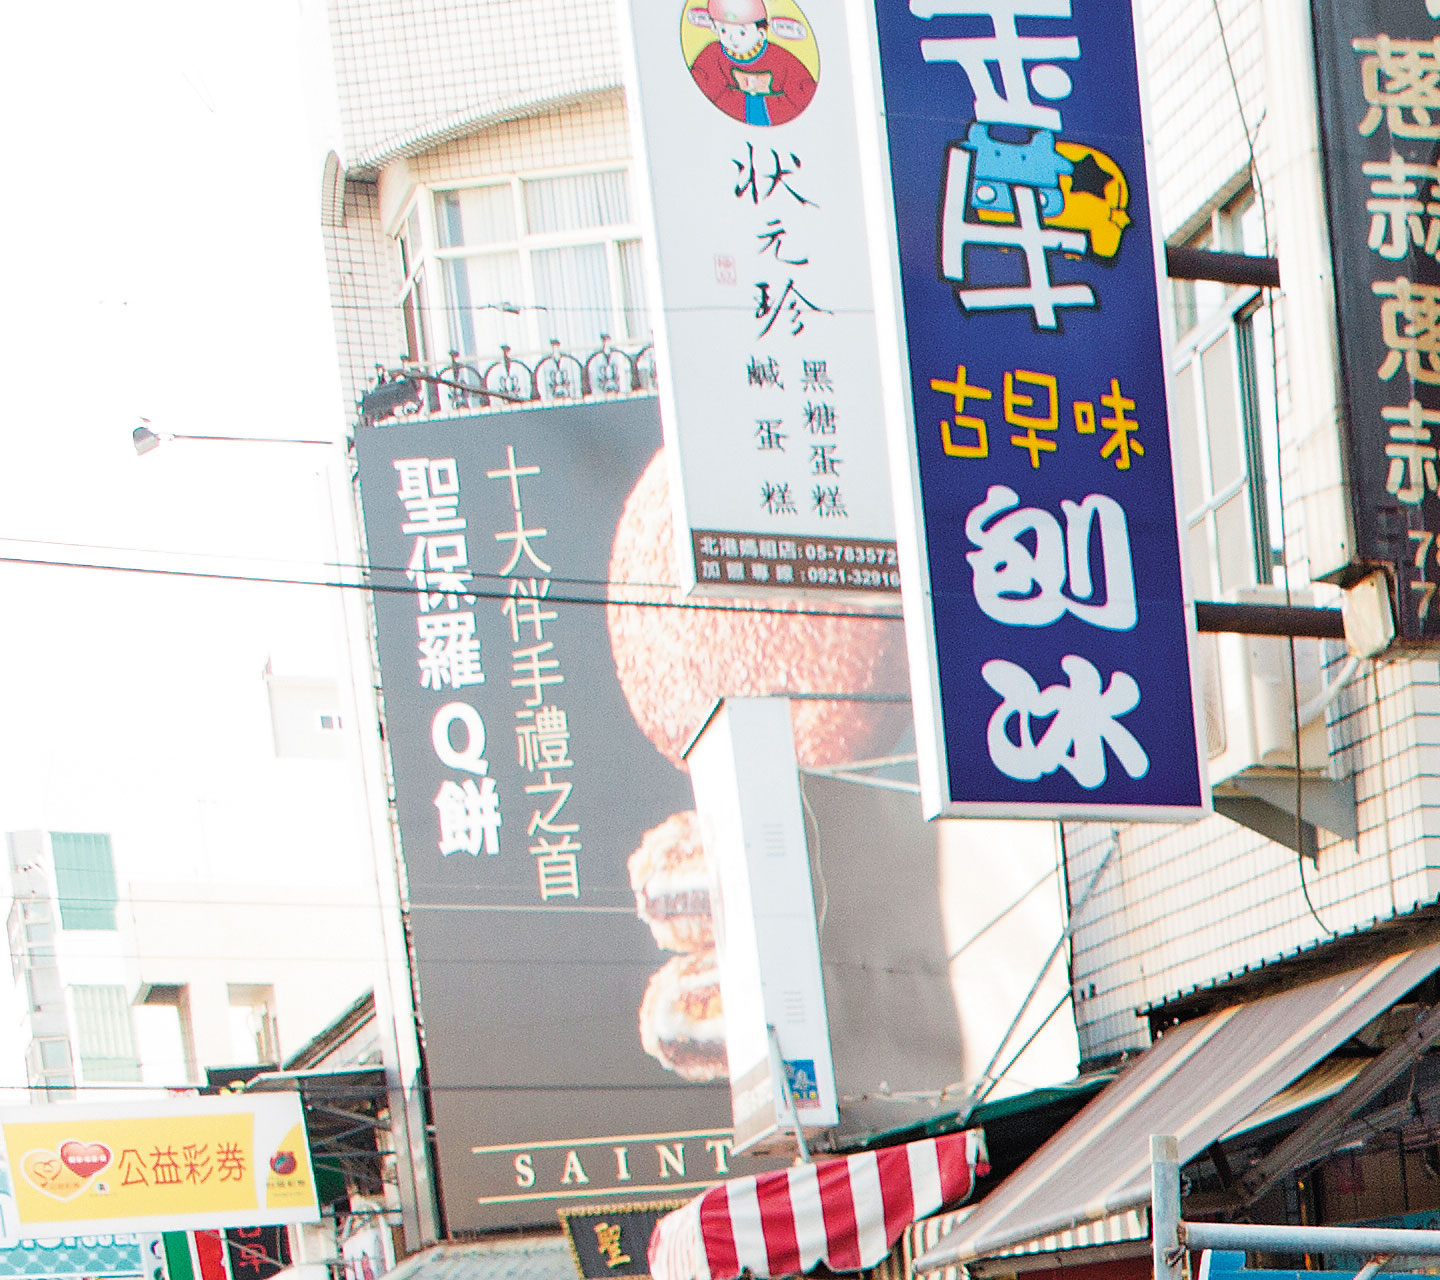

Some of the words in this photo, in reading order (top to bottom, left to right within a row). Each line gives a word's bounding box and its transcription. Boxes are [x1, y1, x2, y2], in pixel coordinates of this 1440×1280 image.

[732, 141, 834, 340] 狀元珍
[747, 355, 798, 515] 鹹蛋糕
[800, 359, 849, 518] 黑糖蛋糕
[930, 365, 1145, 471] 古早味
[392, 457, 502, 857] 聖保羅Q餅
[486, 445, 581, 901] 十大伴手禮之首
[966, 484, 1151, 790] 刨冰
[118, 1141, 247, 1188] 公益彩券
[513, 1138, 734, 1189] SAINT
